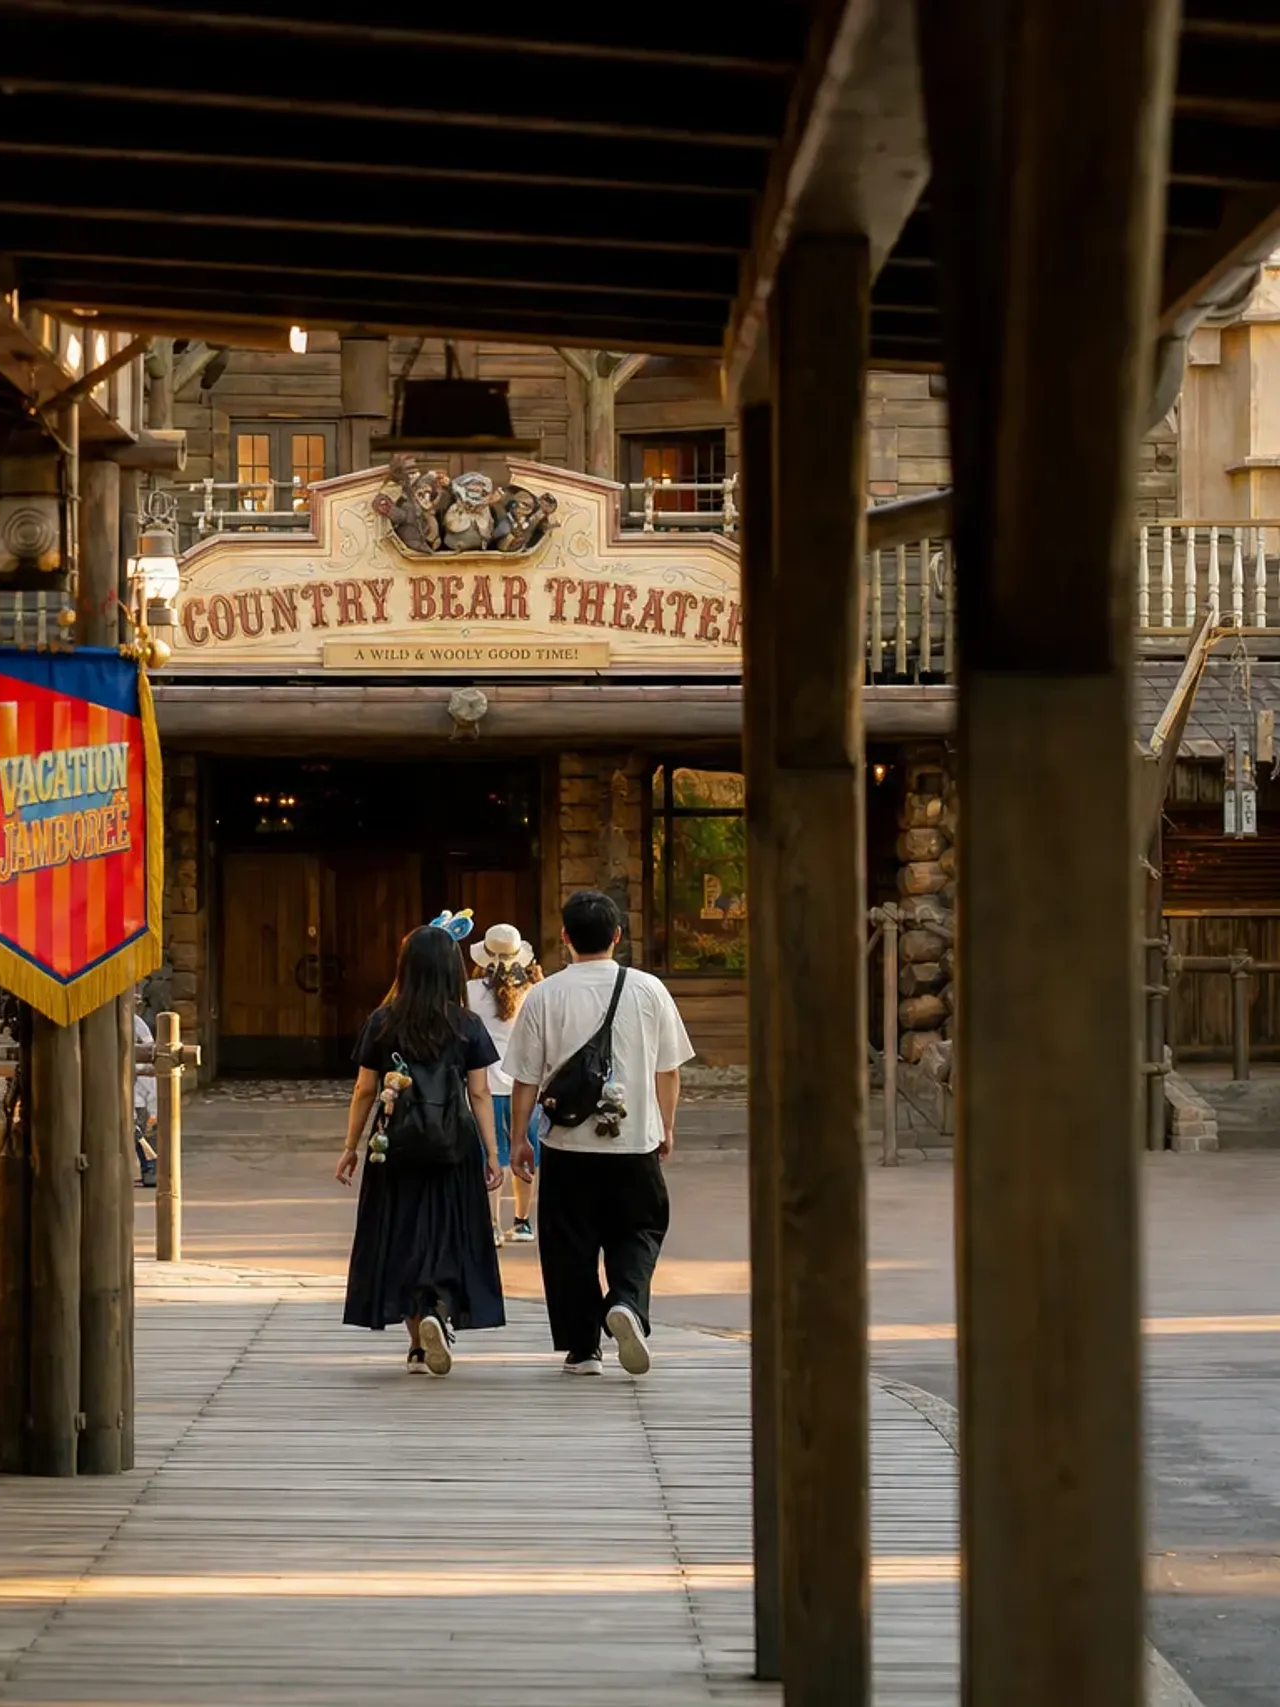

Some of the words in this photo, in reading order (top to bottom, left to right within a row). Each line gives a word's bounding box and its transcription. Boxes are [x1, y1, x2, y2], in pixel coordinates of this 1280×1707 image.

[182, 576, 394, 646] COUNTRY
[408, 574, 531, 621] BEAR
[354, 649, 365, 661] A
[370, 649, 410, 661] WILD
[414, 650, 425, 661] &
[430, 648, 483, 661] WOOLY
[488, 648, 531, 660] GOOD
[535, 647, 579, 660] TIME!
